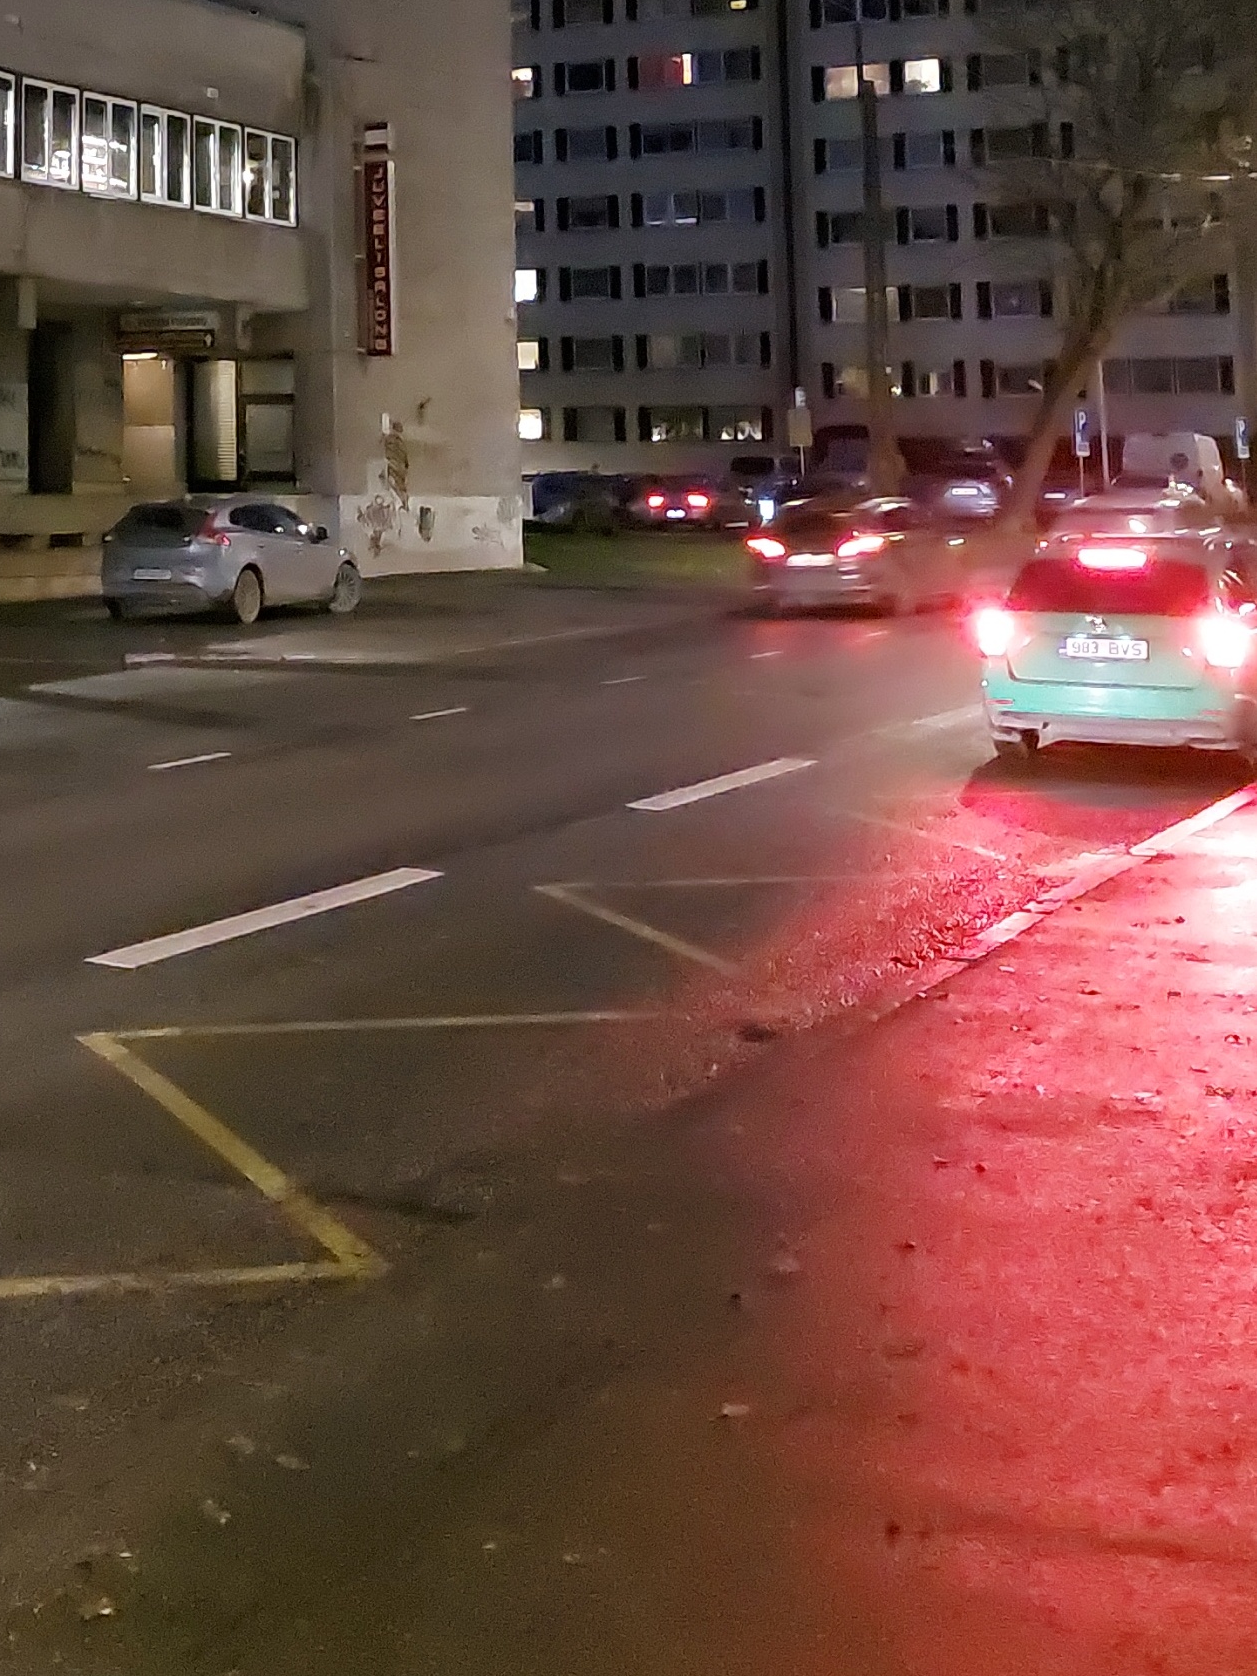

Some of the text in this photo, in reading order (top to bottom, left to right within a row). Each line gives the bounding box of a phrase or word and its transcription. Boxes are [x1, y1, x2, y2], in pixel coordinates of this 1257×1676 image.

[1078, 411, 1087, 431] P
[1072, 641, 1142, 656] 983 BVS
